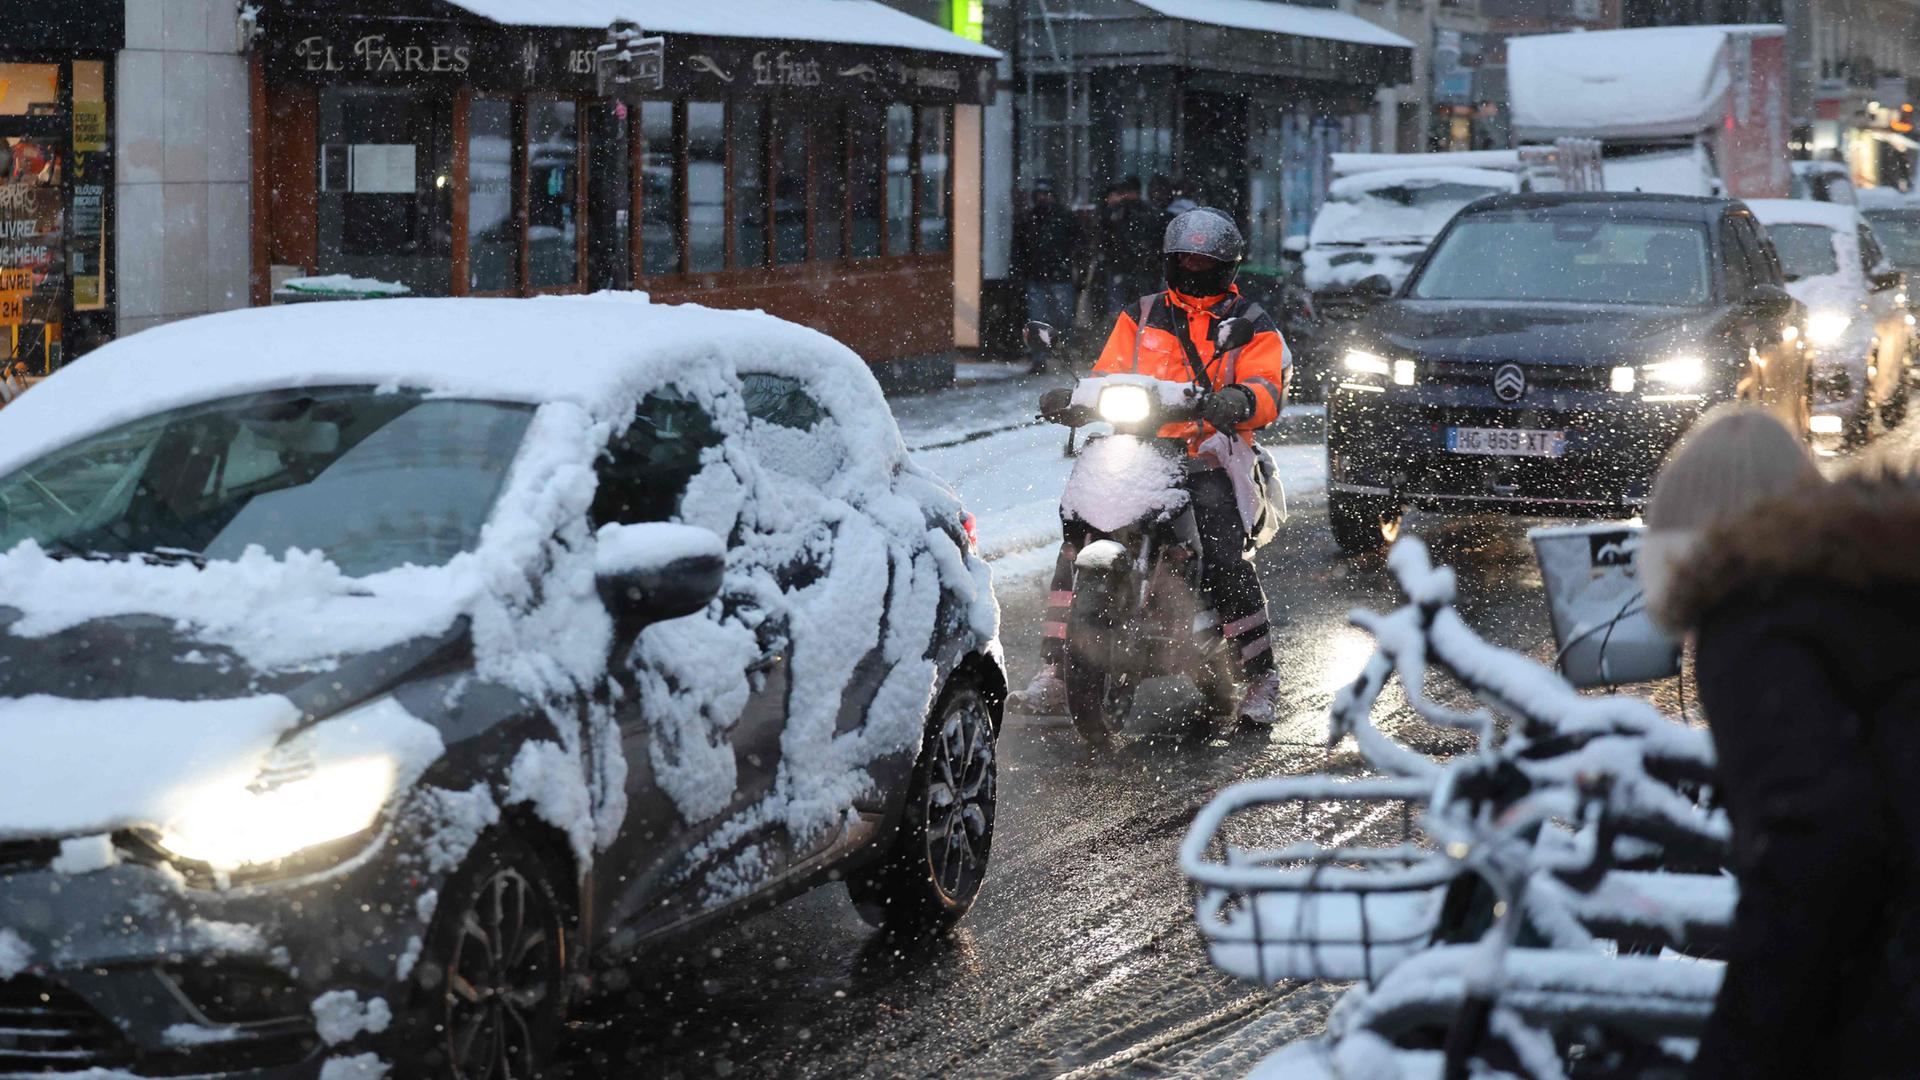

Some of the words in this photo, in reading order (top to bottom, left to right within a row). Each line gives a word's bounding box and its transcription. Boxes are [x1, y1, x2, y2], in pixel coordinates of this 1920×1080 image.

[295, 35, 345, 72] EL
[354, 34, 470, 72] FARES
[0, 220, 37, 238] LIVREZ
